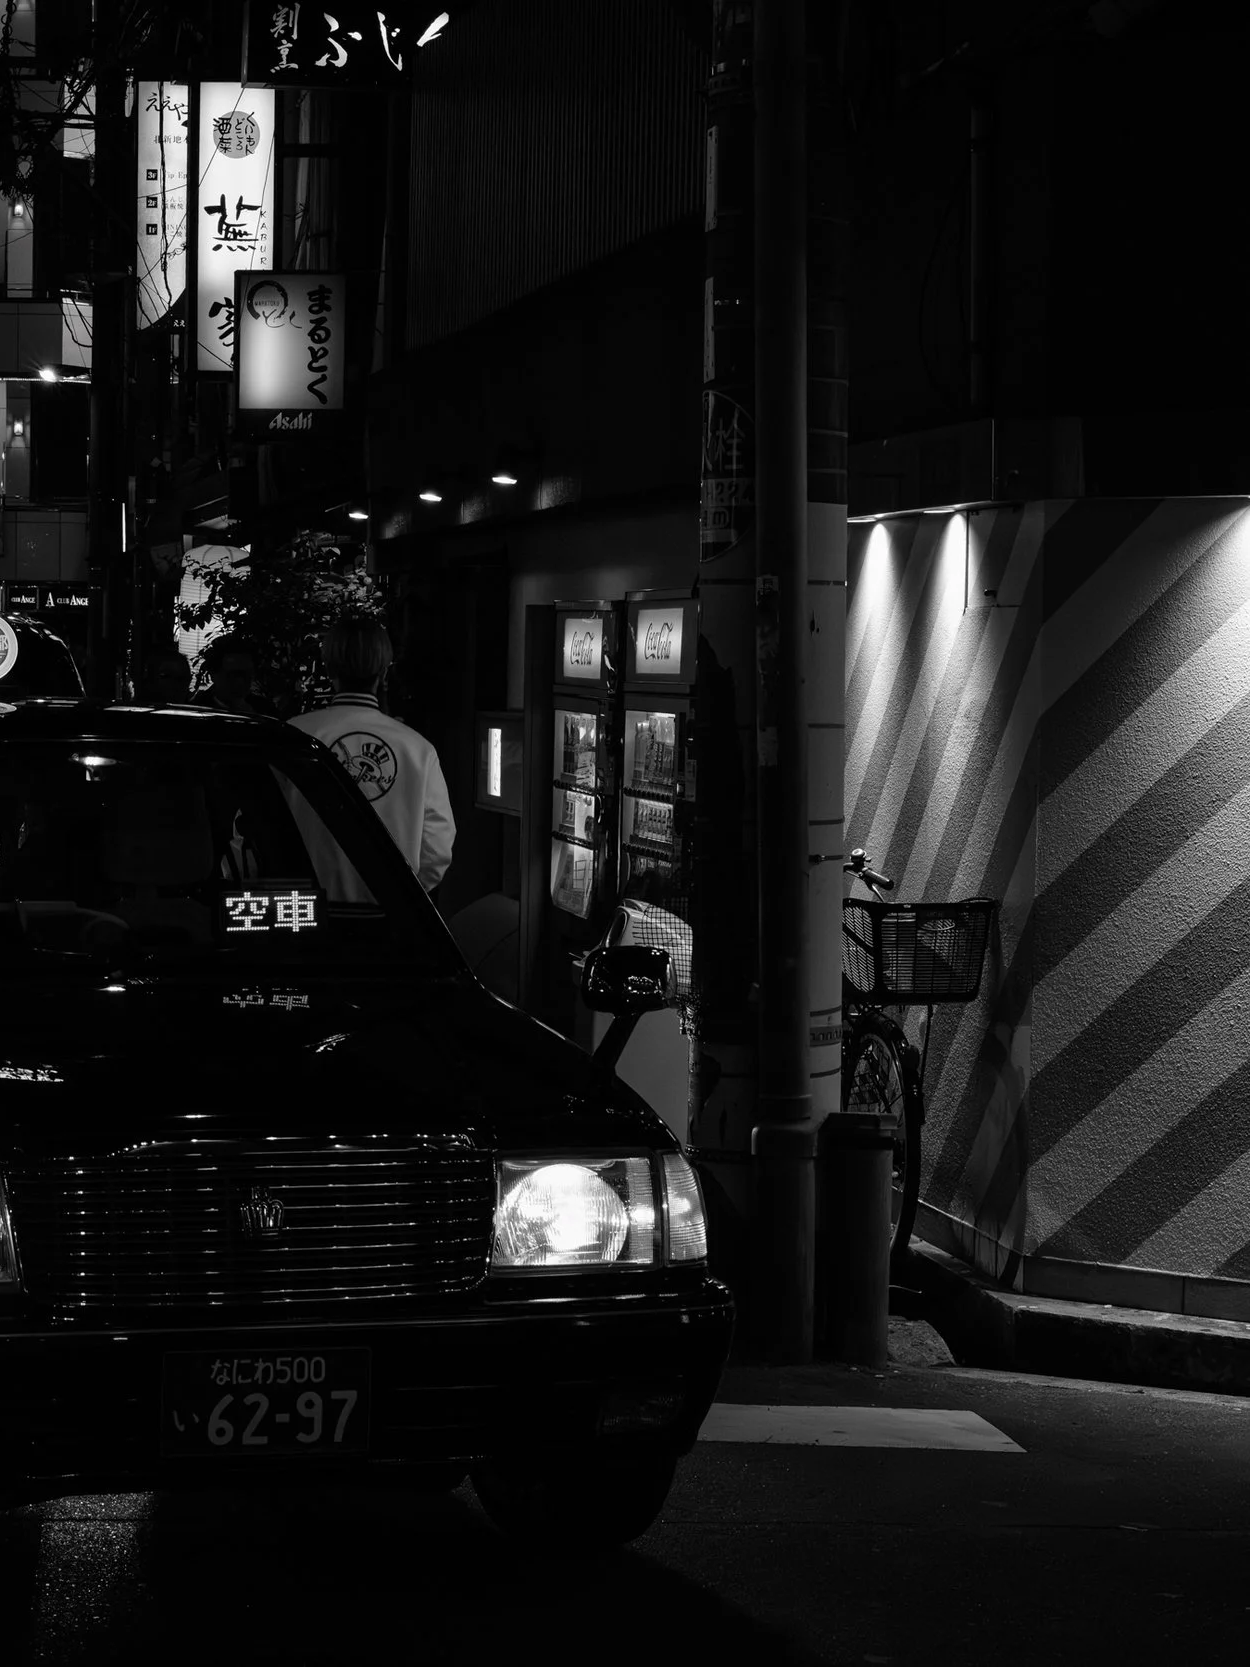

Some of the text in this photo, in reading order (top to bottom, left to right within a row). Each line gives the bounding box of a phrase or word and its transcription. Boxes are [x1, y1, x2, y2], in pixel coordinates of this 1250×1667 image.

[307, 284, 332, 404] まるとく
[269, 411, 314, 430] Asahi
[225, 890, 318, 932] 空車
[210, 1356, 326, 1385] なにわ500
[173, 1390, 358, 1446] い 62-97
